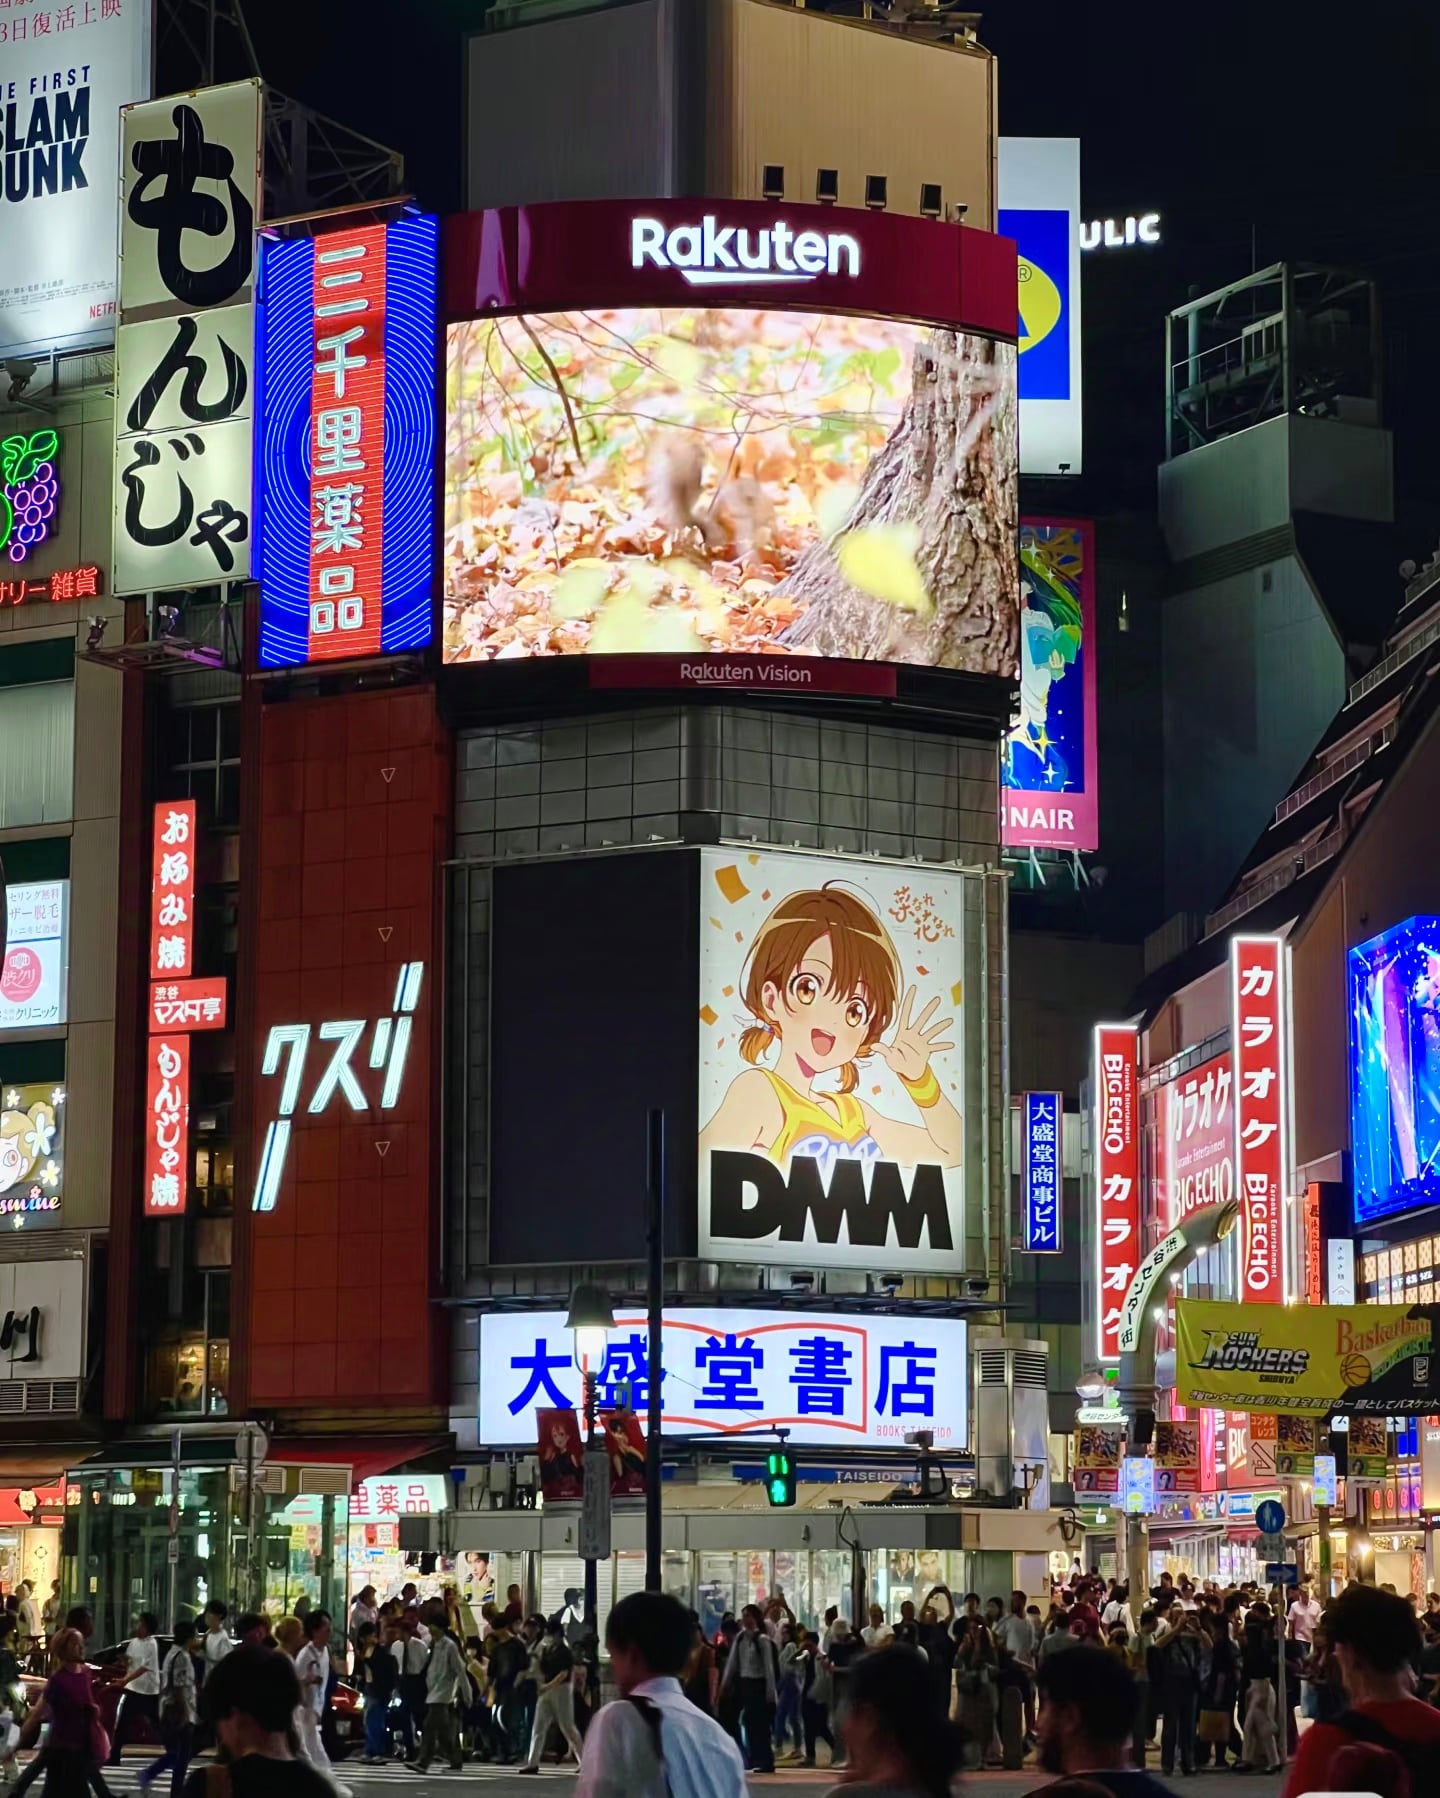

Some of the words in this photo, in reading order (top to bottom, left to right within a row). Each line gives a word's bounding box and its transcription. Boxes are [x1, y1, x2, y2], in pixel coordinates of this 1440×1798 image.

[30, 65, 91, 95] FIRST
[0, 86, 90, 154] LAM
[0, 137, 89, 203] UNK
[631, 214, 862, 287] Rakuten
[122, 104, 254, 572] もんじゃ
[310, 245, 370, 637] 三千里薬品
[51, 566, 98, 600] 雑貨
[680, 662, 753, 685] Rakuten
[757, 664, 812, 682] Vision
[1001, 806, 1075, 830] NAIR
[157, 811, 189, 970] お好み焼
[1104, 1053, 1123, 1097] BIG
[1240, 964, 1278, 1150] カラオケ
[150, 1042, 184, 1207] もんじゃ焼
[1105, 1099, 1125, 1155] ECHO
[1174, 1066, 1232, 1142] カラオケ
[710, 1149, 955, 1251] DMM
[1031, 1102, 1056, 1243] 大盛堂商事ビル
[1195, 1156, 1233, 1206] ECHO
[1245, 1172, 1268, 1219] BIG
[1269, 1183, 1278, 1217] Karaoke
[1247, 1222, 1270, 1291] ECHO
[1270, 1219, 1278, 1278] Entertainment
[1122, 1237, 1178, 1348] 渋谷センター街
[1189, 1330, 1308, 1374] ROCKERS
[1228, 1331, 1258, 1346] SUN
[507, 1333, 937, 1418] 大盛堂書店
[1258, 1374, 1295, 1384] SHIBUYA
[876, 1424, 906, 1437] BOOKS
[835, 1470, 904, 1481] TAISEIDO
